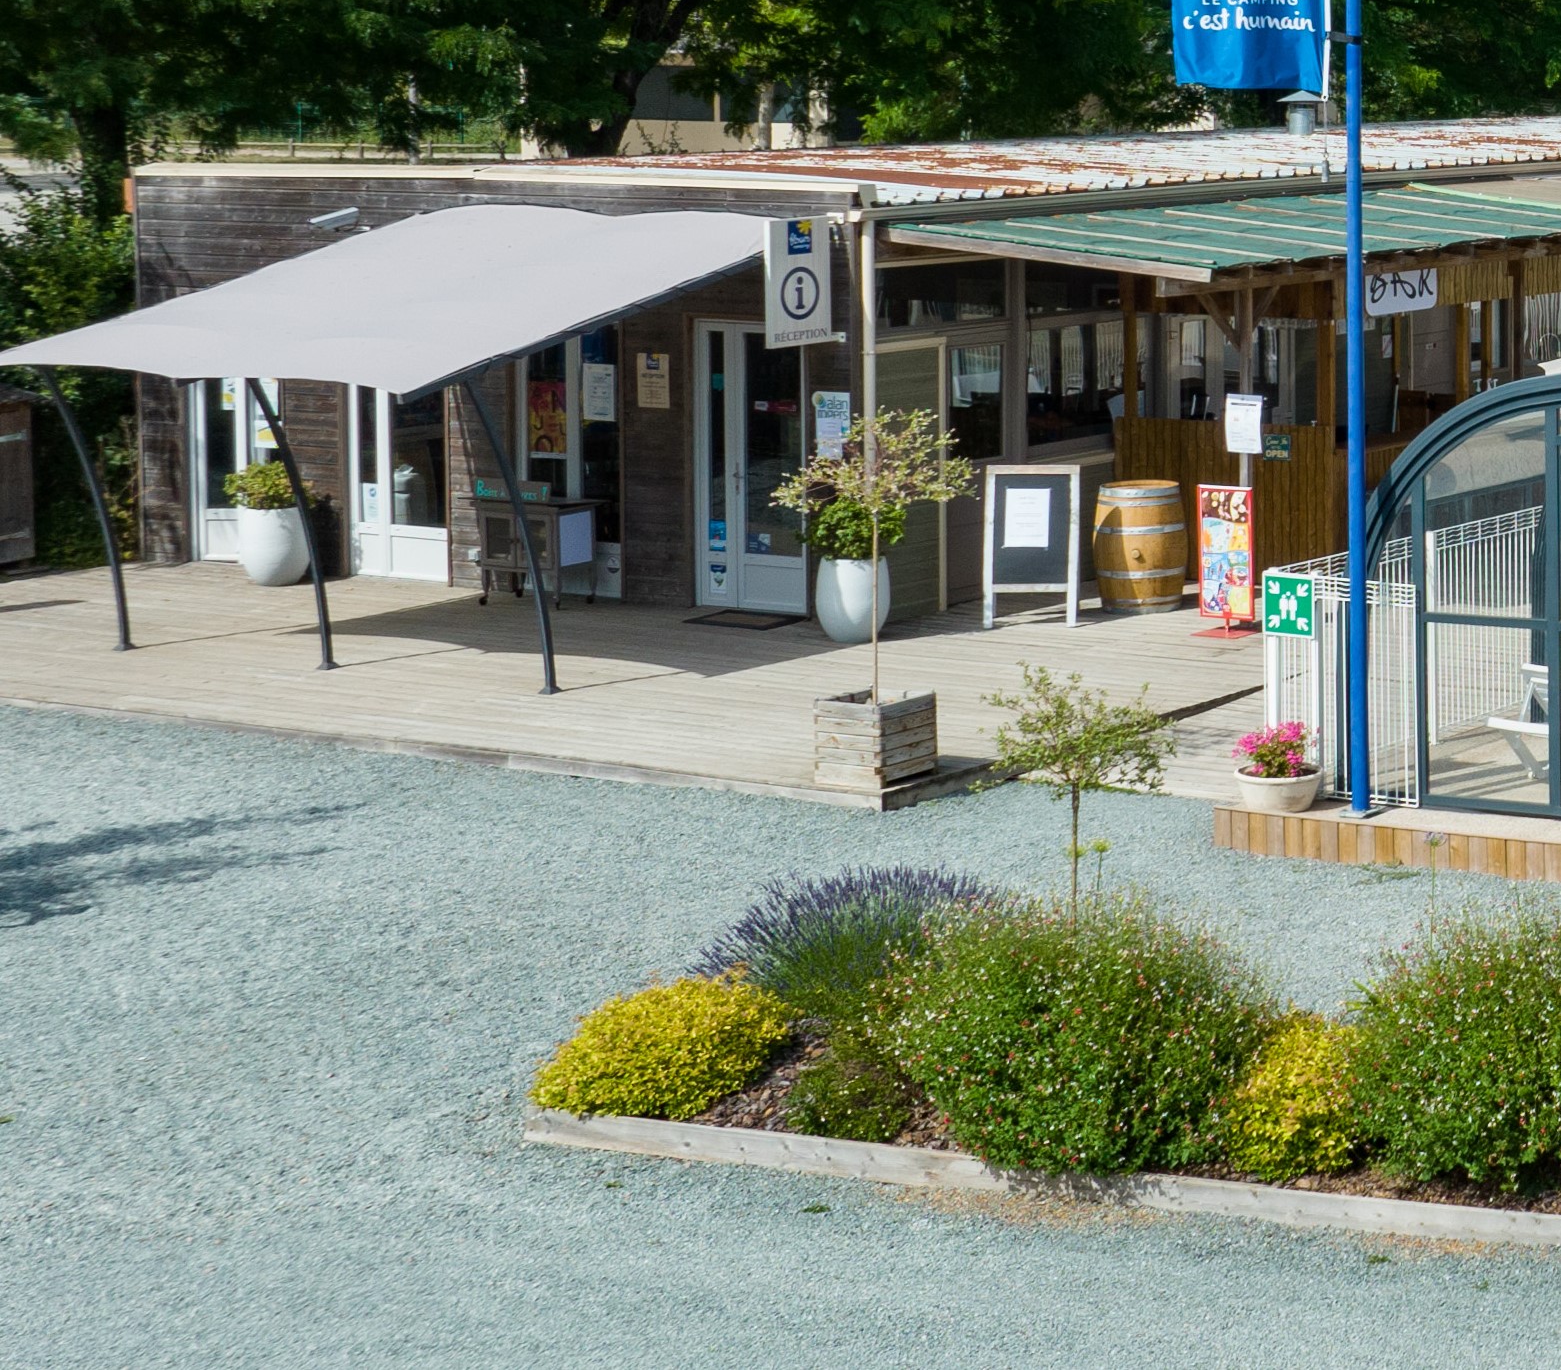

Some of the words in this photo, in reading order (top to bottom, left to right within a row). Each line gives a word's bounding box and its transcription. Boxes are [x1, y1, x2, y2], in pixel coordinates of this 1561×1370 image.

[1182, 7, 1230, 31] c'est
[1235, 6, 1316, 33] humain
[774, 327, 828, 342] RÉCEPTION
[826, 395, 848, 410] alan
[1265, 449, 1289, 458] OPEN
